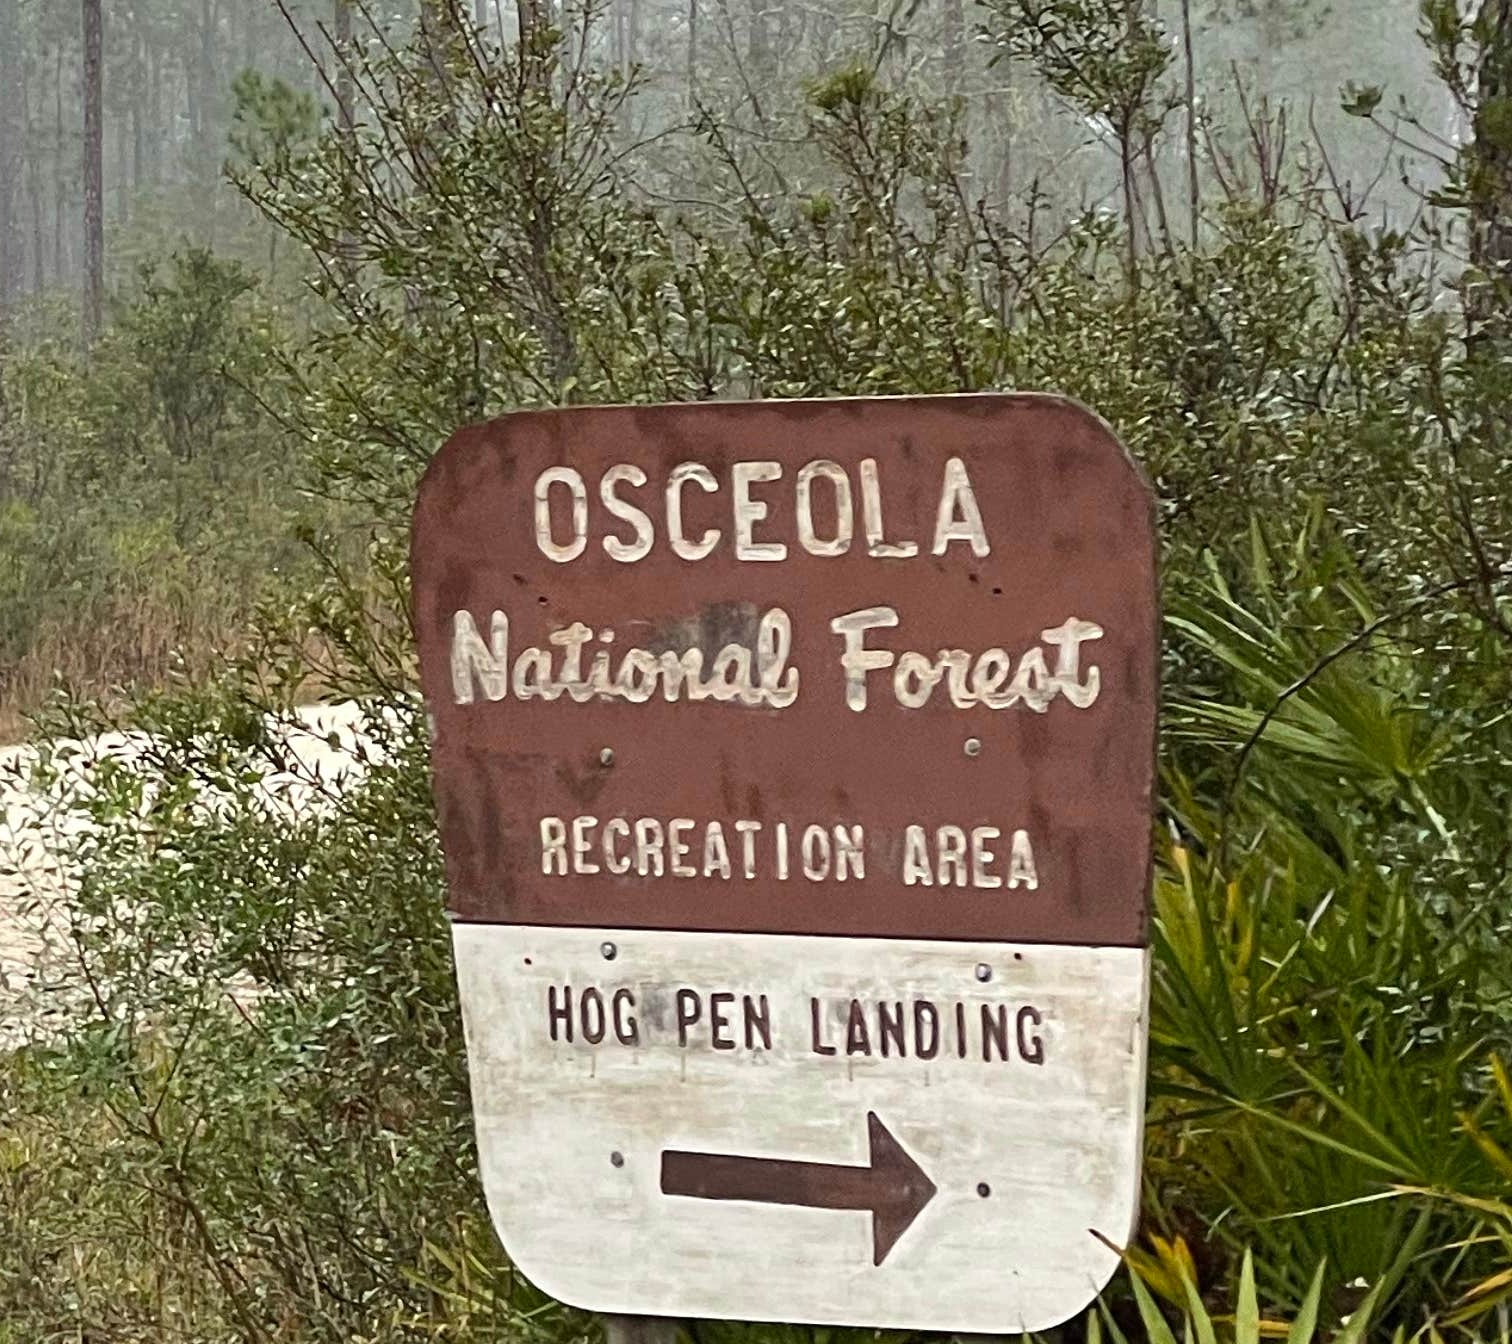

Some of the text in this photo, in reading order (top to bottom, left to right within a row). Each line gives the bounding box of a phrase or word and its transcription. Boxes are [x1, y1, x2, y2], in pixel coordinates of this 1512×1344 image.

[534, 457, 990, 562] OSCEOLA
[451, 606, 1104, 712] National Forest
[540, 816, 1040, 890] RECREATION AREA
[548, 984, 1046, 1066] HOG PEN LANDING
